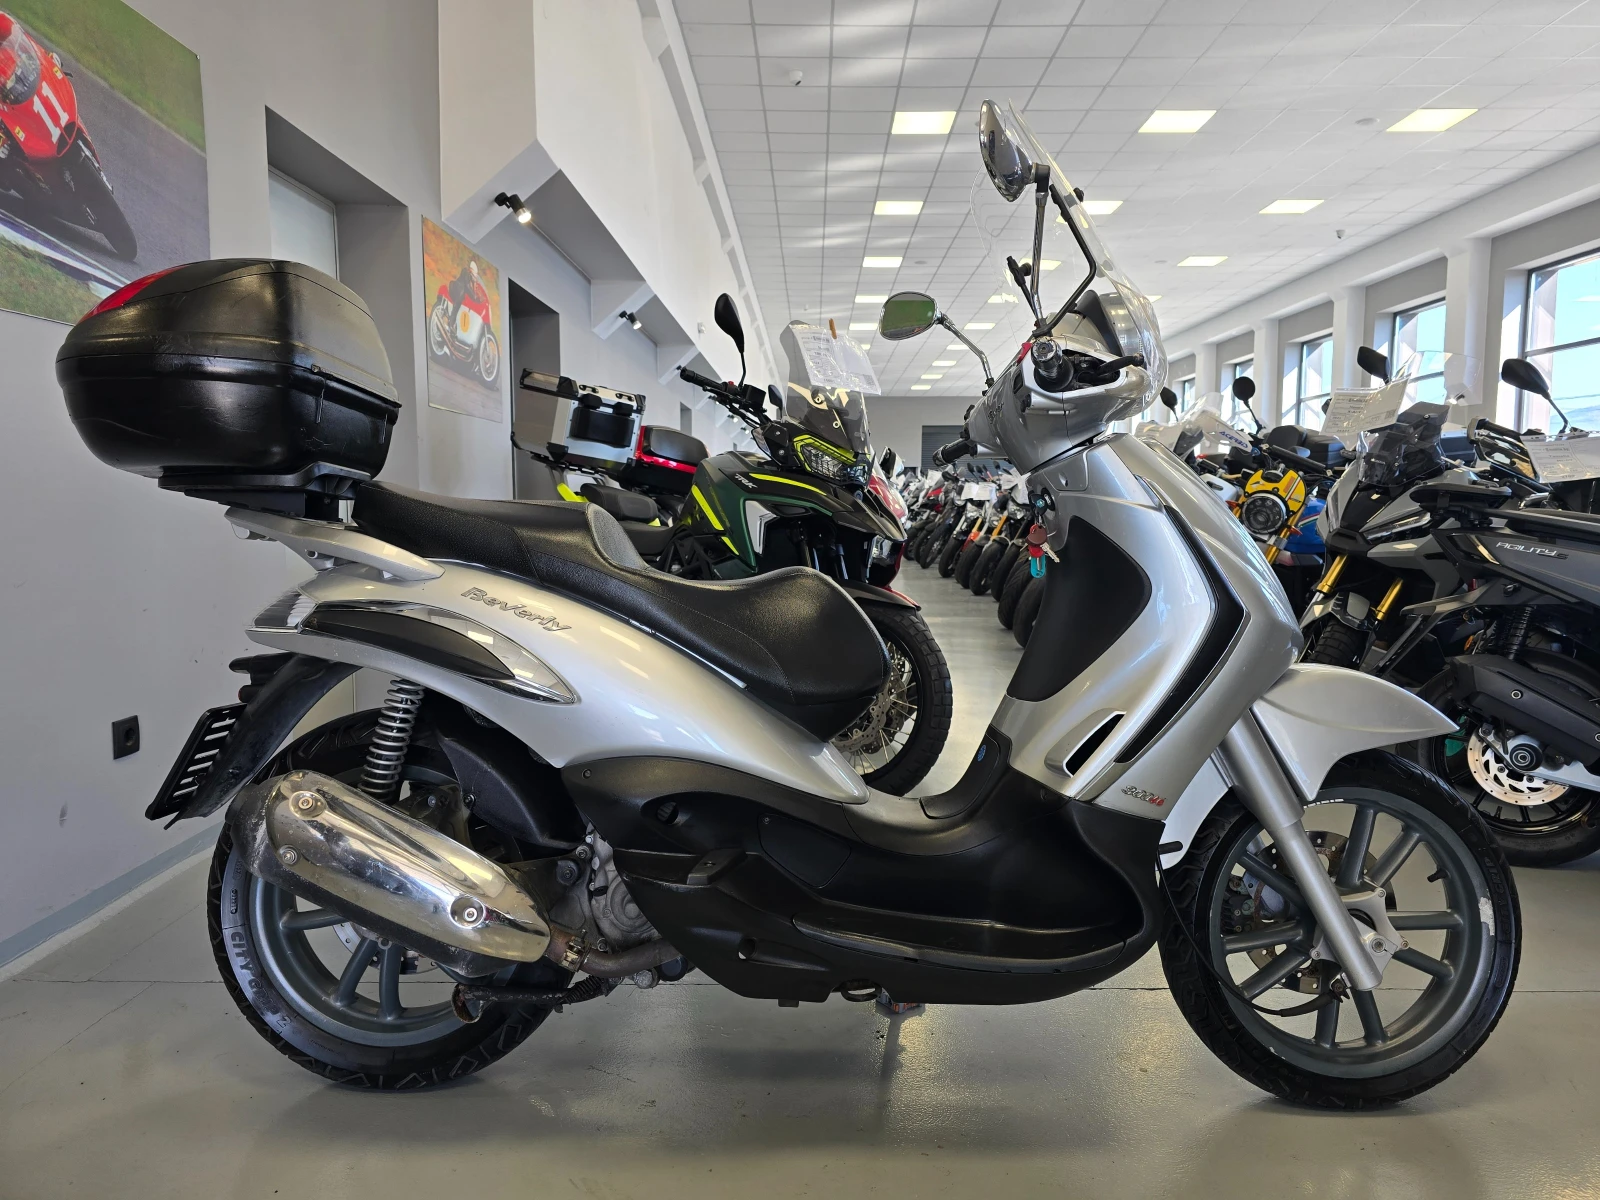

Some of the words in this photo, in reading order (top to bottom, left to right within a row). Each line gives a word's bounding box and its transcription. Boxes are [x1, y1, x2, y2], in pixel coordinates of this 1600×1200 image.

[33, 81, 69, 144] 11
[734, 473, 758, 488] TRK
[1496, 541, 1557, 557] AGILITY
[231, 931, 254, 973] CITY
[276, 1015, 292, 1030] 2
